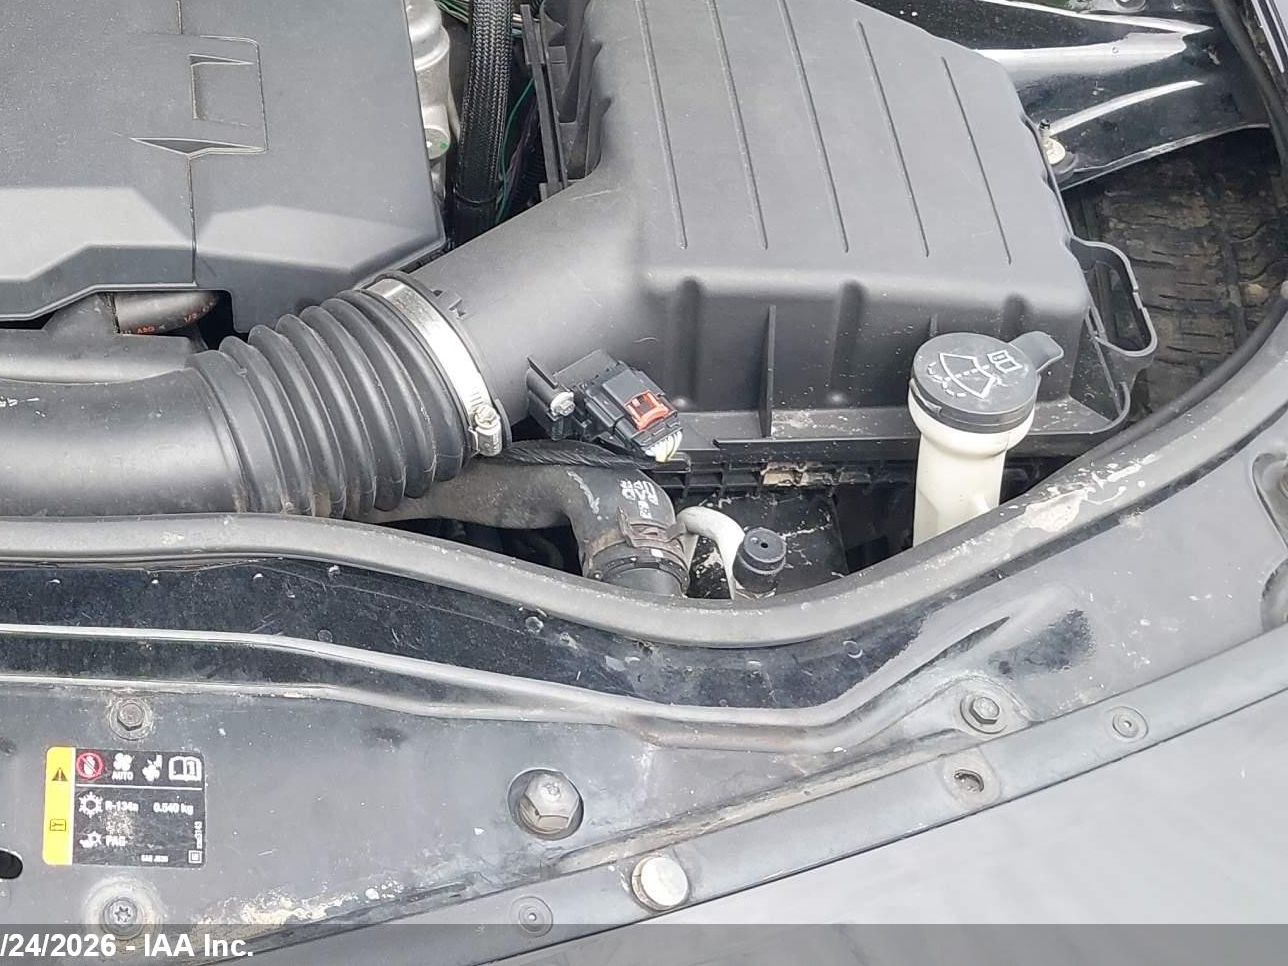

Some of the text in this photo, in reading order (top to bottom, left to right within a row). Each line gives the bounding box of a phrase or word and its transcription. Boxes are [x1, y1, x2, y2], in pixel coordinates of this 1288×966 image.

[111, 771, 134, 782] AUTO
[105, 800, 140, 813] R-134a
[181, 803, 194, 816] kg
